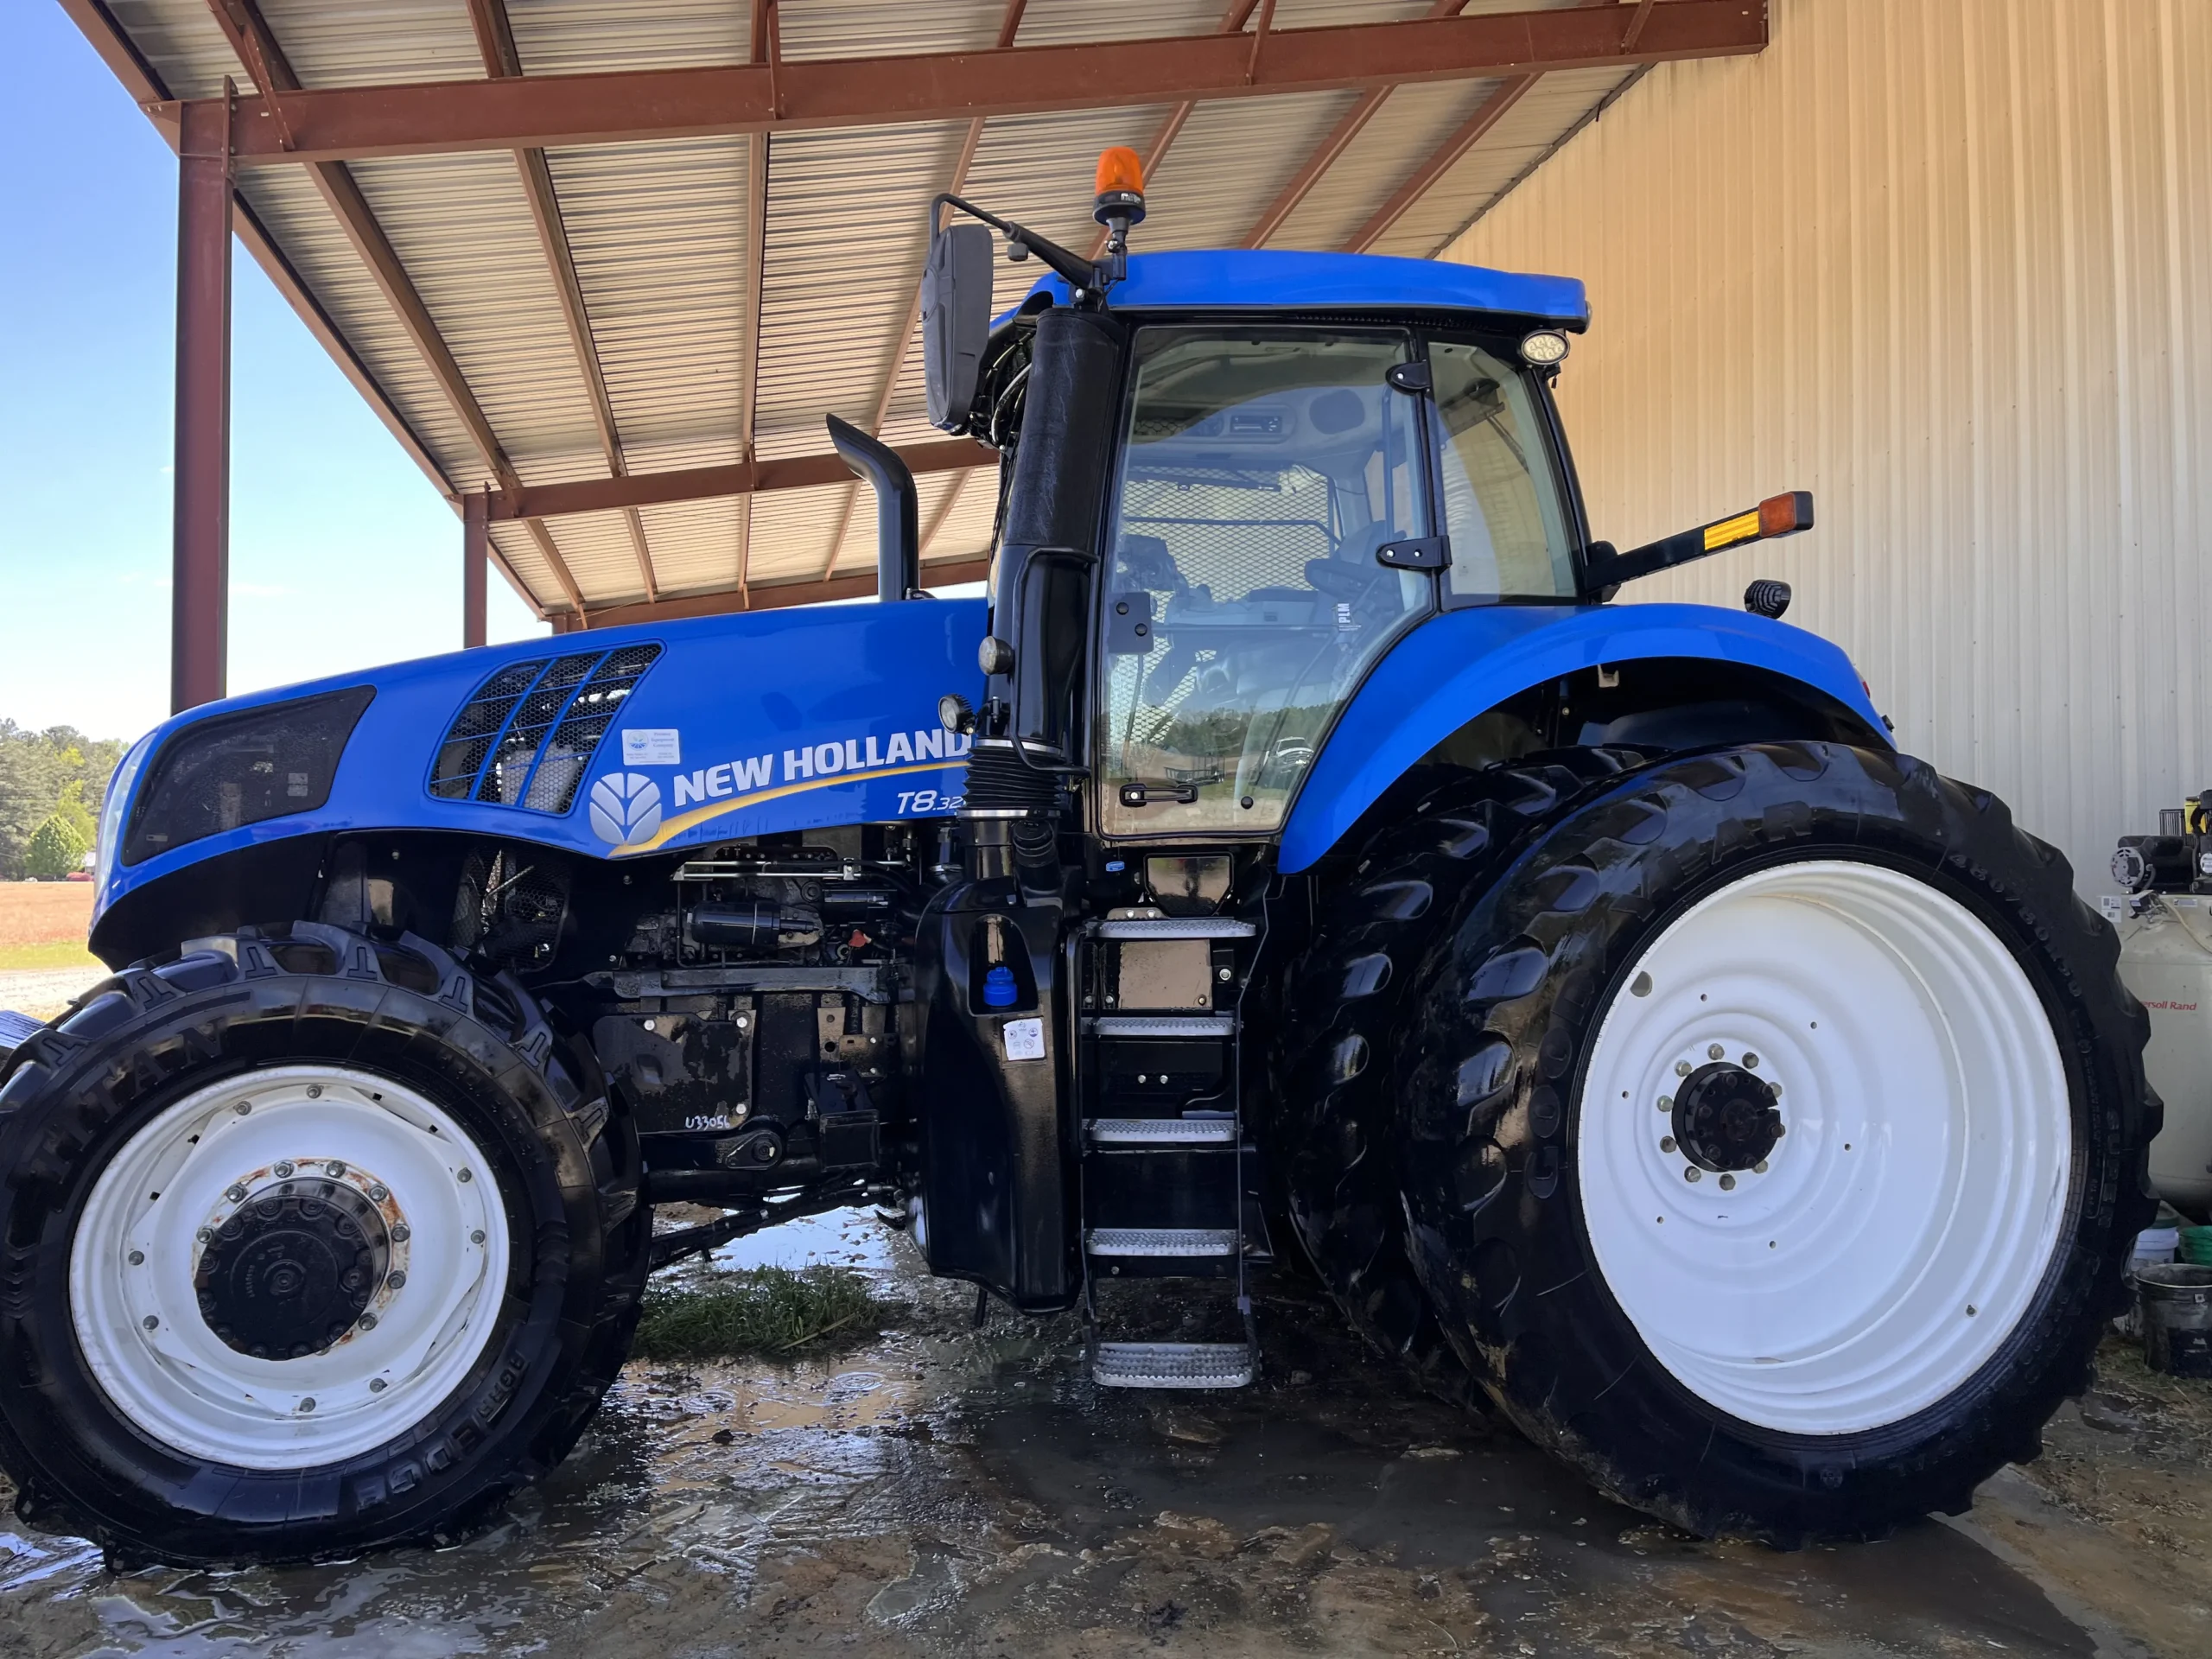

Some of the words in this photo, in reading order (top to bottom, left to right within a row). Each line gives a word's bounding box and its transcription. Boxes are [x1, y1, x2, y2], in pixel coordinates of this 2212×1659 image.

[1337, 602, 1351, 624] PLM
[673, 753, 773, 807] NEW
[783, 728, 972, 781] HOLLAND
[897, 790, 966, 815] T8.32
[2170, 1001, 2197, 1011] Rand
